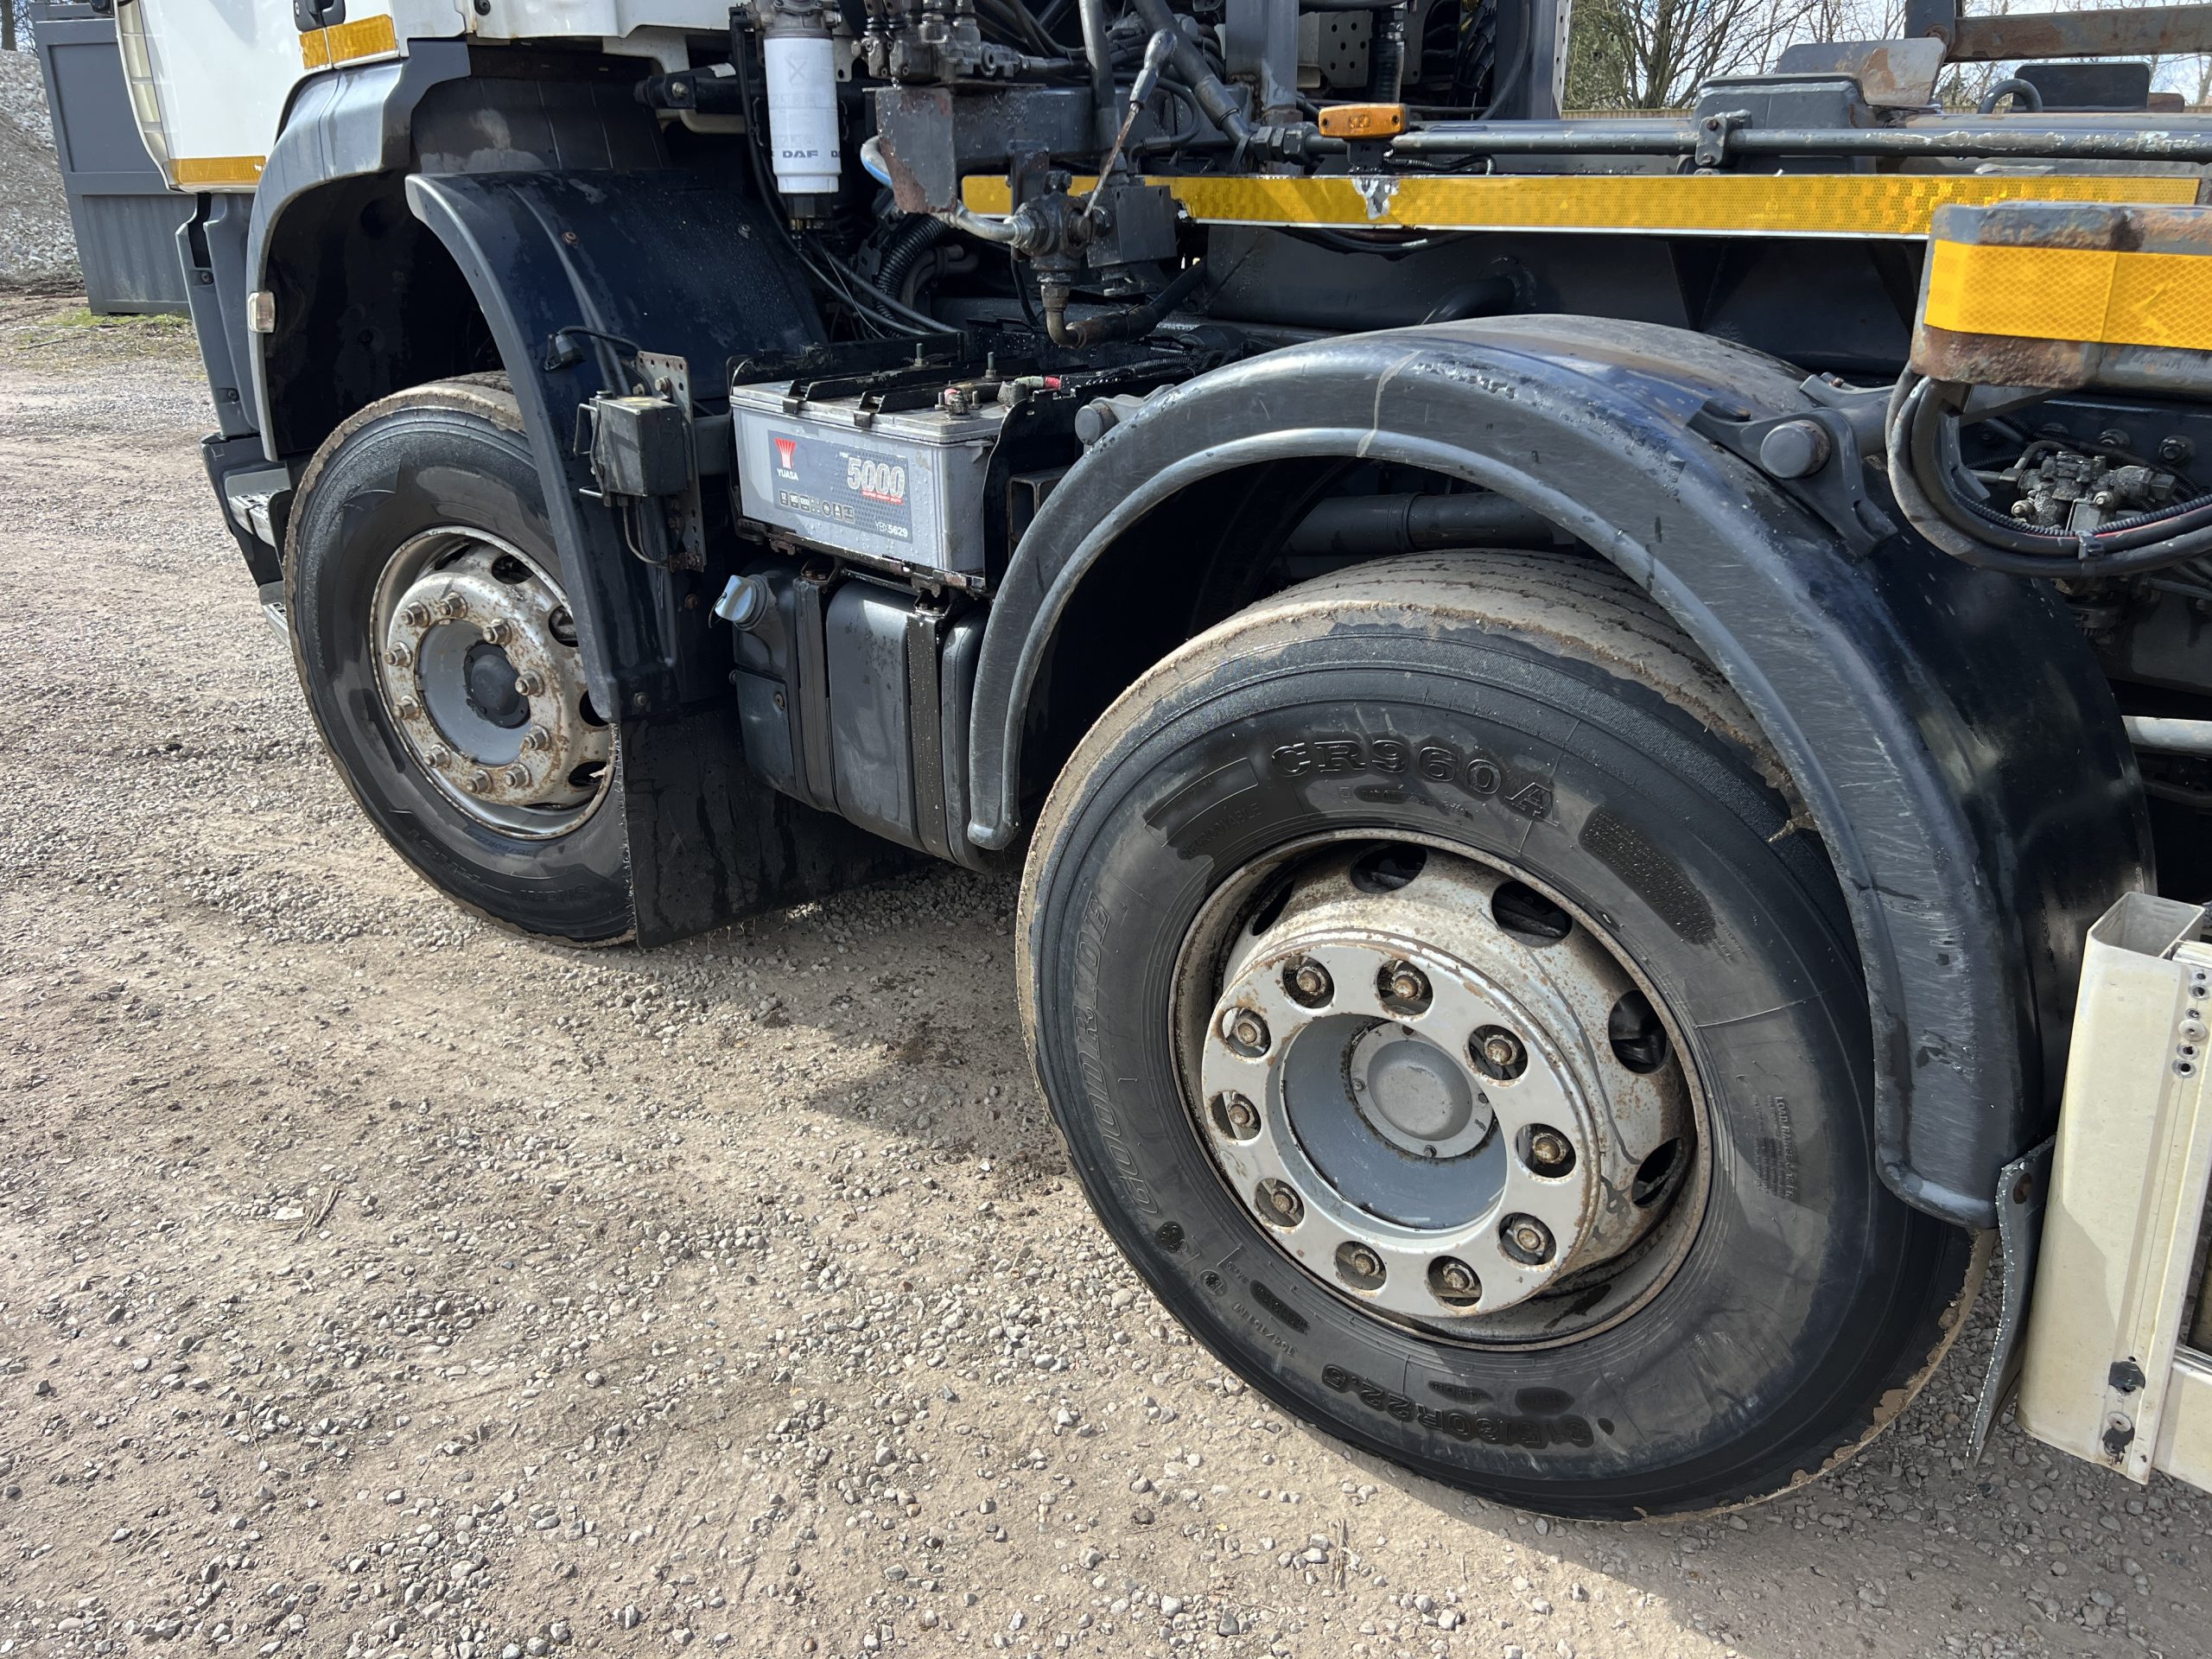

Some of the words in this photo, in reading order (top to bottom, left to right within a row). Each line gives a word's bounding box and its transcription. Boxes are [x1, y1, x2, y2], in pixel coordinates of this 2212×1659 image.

[782, 149, 819, 158] DAF
[776, 467, 799, 481] YUASA
[847, 456, 906, 499] 5000
[874, 520, 908, 537] YBX5629
[1271, 740, 1560, 827] CR960A
[1072, 891, 1160, 1215] GOODRIDE
